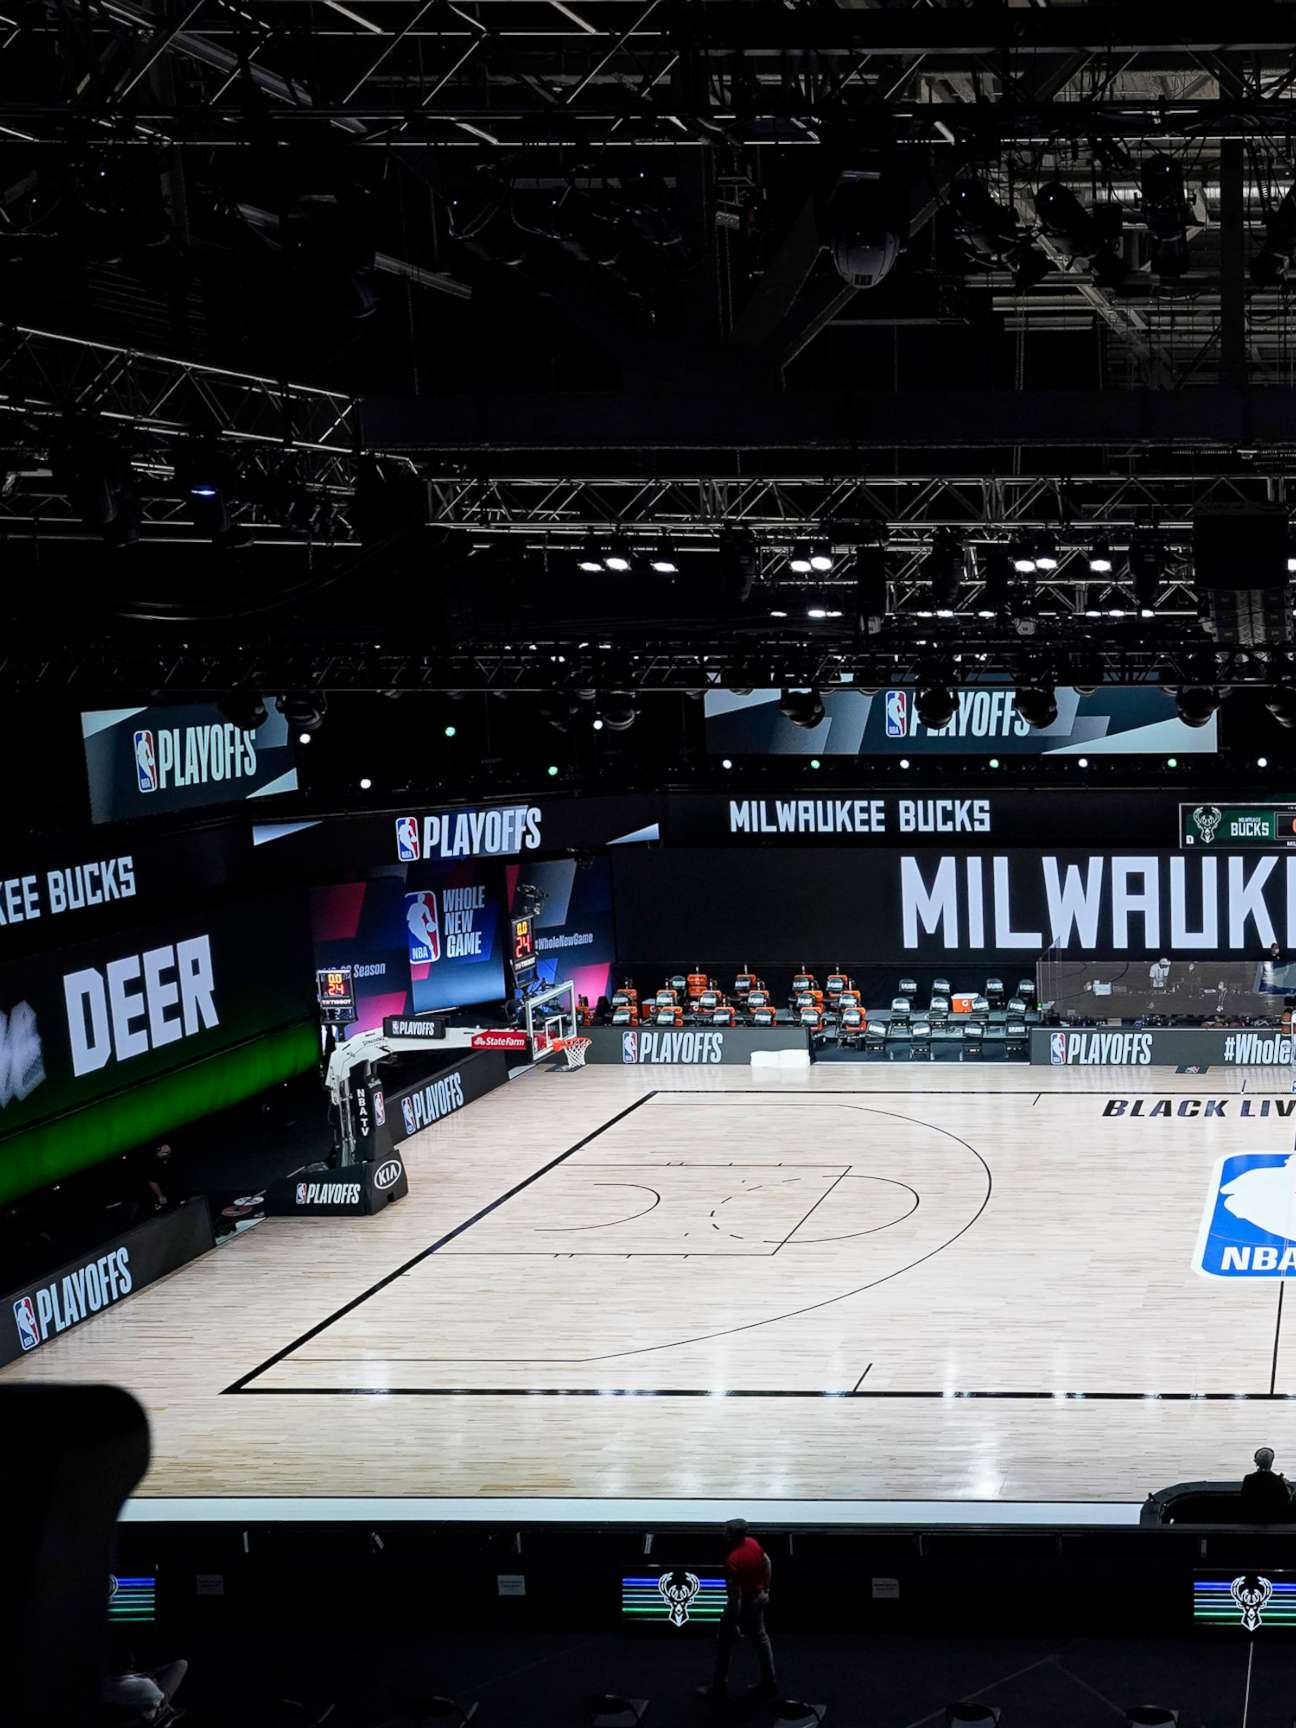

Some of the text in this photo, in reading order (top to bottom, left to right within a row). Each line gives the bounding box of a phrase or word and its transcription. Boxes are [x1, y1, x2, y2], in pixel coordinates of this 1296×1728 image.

[909, 692, 1031, 736] PYOFF
[158, 723, 257, 789] PLAYOFFS
[730, 800, 991, 832] MILWAUKEE BUCKS
[1230, 822, 1270, 836] BUCKS
[423, 807, 542, 859] PLAYOFFS
[47, 856, 137, 914] BUCKS
[443, 886, 486, 912] WHOLE
[444, 910, 474, 935] NEW
[412, 947, 429, 960] NBA
[447, 931, 482, 959] GAME
[515, 935, 531, 958] 24
[353, 963, 386, 979] Season
[328, 984, 345, 996] 24
[63, 934, 220, 1078] DEER
[400, 1021, 435, 1036] PLAYOFFS
[639, 1032, 723, 1064] PLAYOFFS
[1067, 1033, 1152, 1065] PLAYOFFS
[356, 1088, 370, 1137] NBA TV
[412, 1071, 464, 1130] PLAYOFFS
[1102, 1099, 1228, 1118] BLACK
[378, 1164, 398, 1186] KIA
[306, 1183, 361, 1204] PLAYOFFS
[35, 1246, 133, 1340] PLAYOFFS
